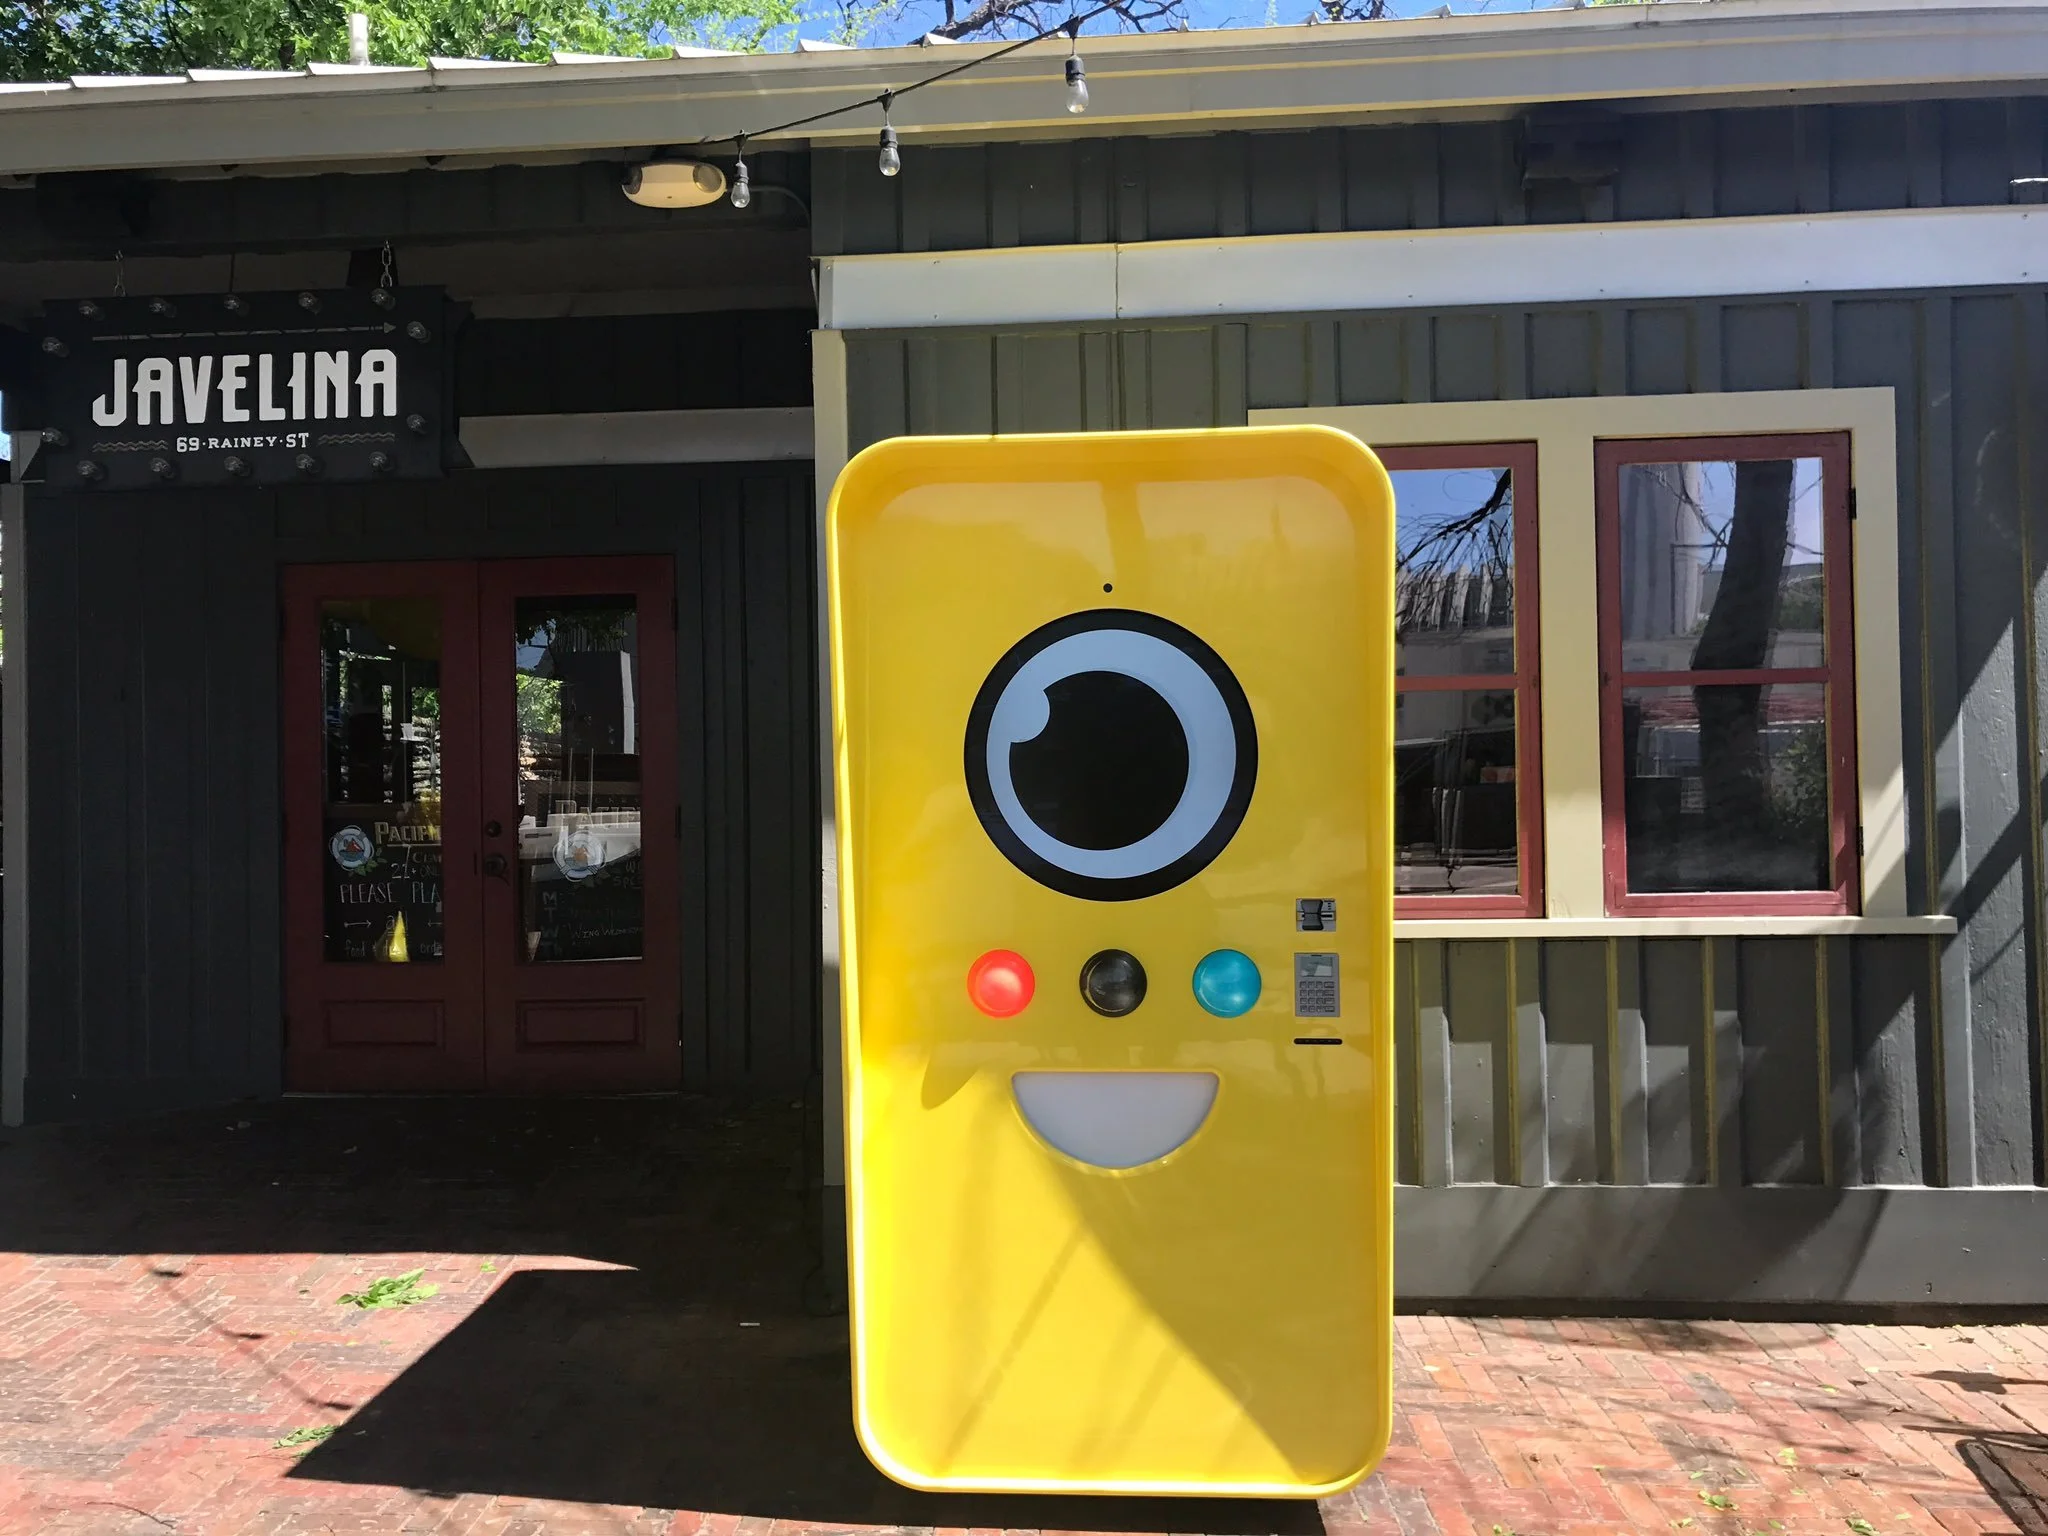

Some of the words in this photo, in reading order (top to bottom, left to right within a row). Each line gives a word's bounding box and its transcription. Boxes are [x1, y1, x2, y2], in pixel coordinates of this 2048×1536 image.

[92, 348, 398, 428] JAVELINA
[207, 436, 277, 450] RAINEY
[285, 432, 310, 449] ST
[340, 882, 397, 904] PLEASE
